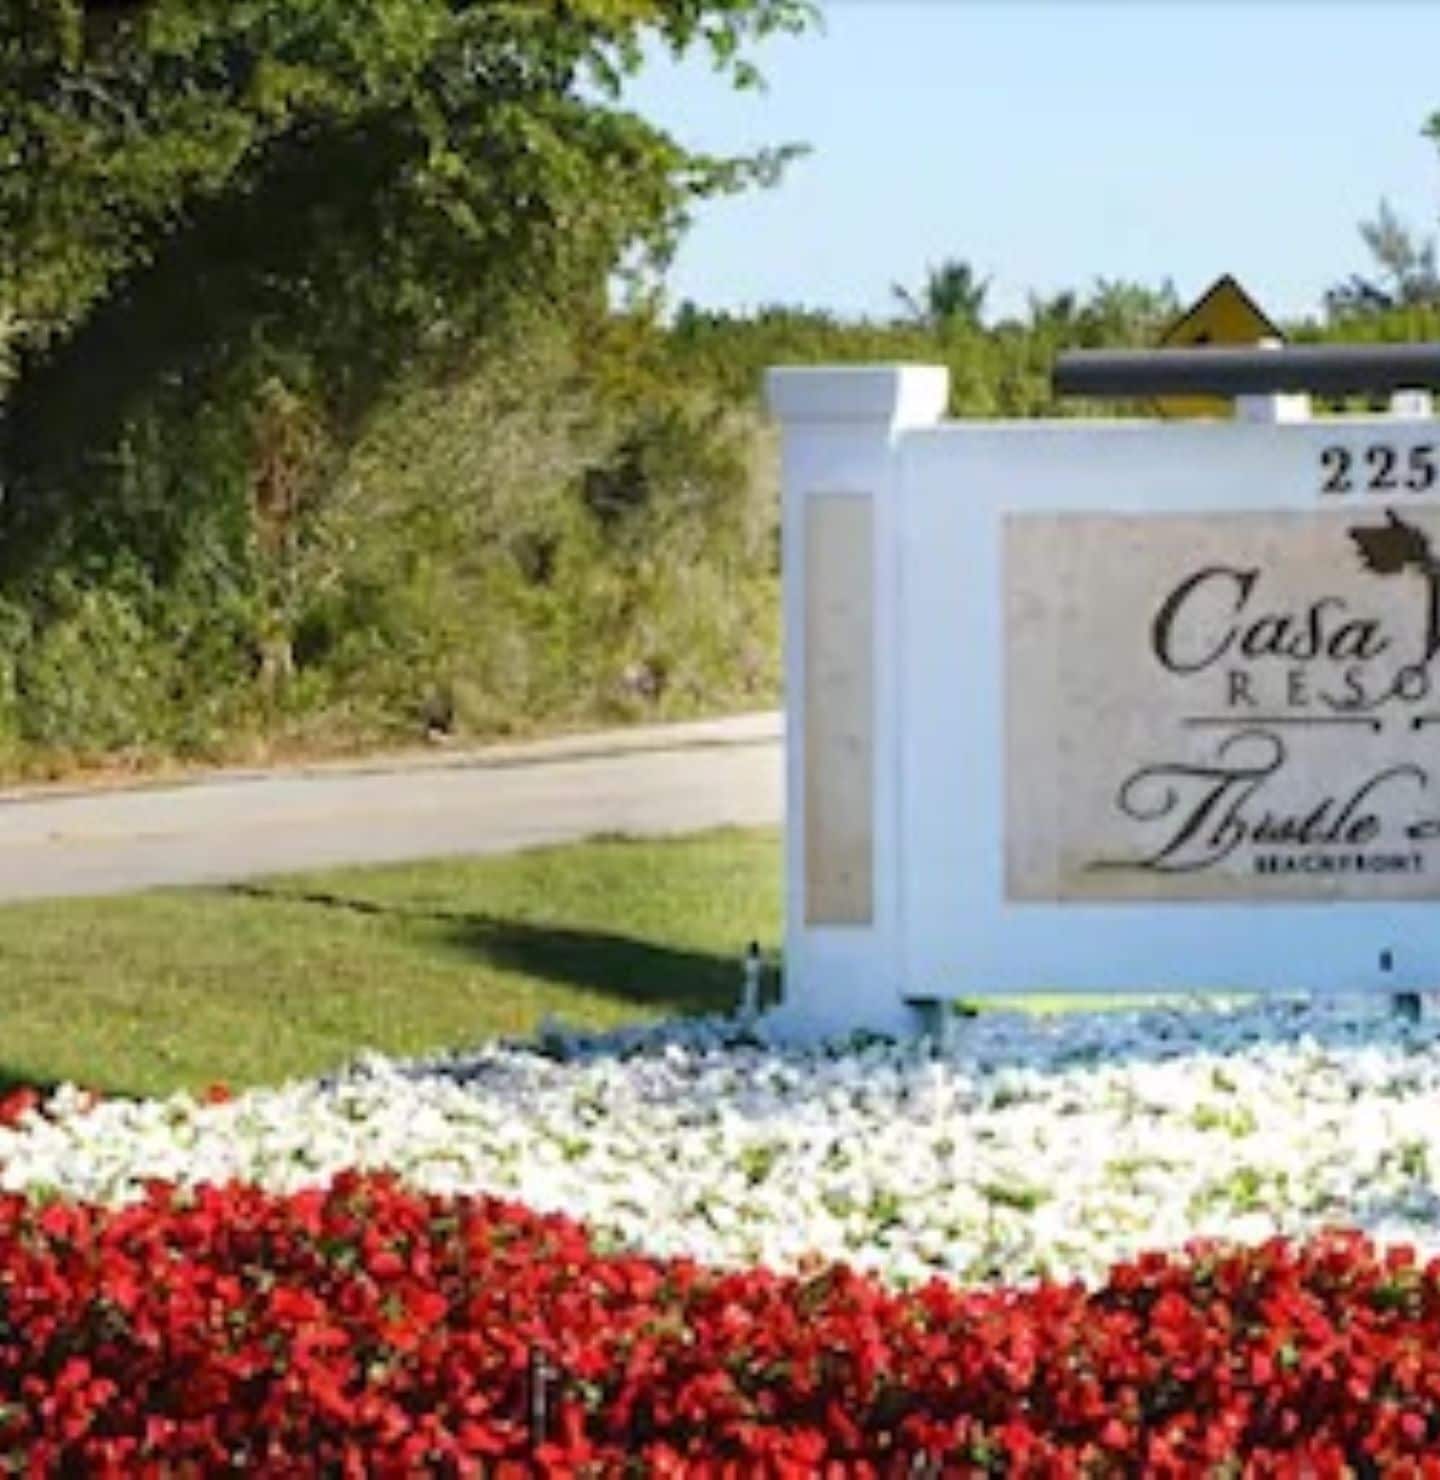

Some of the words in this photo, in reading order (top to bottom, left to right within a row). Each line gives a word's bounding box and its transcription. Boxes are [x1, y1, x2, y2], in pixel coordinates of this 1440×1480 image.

[1153, 566, 1391, 675] Casa
[1085, 728, 1427, 873] Thistle
[1254, 854, 1422, 875] BEACHFRONT
